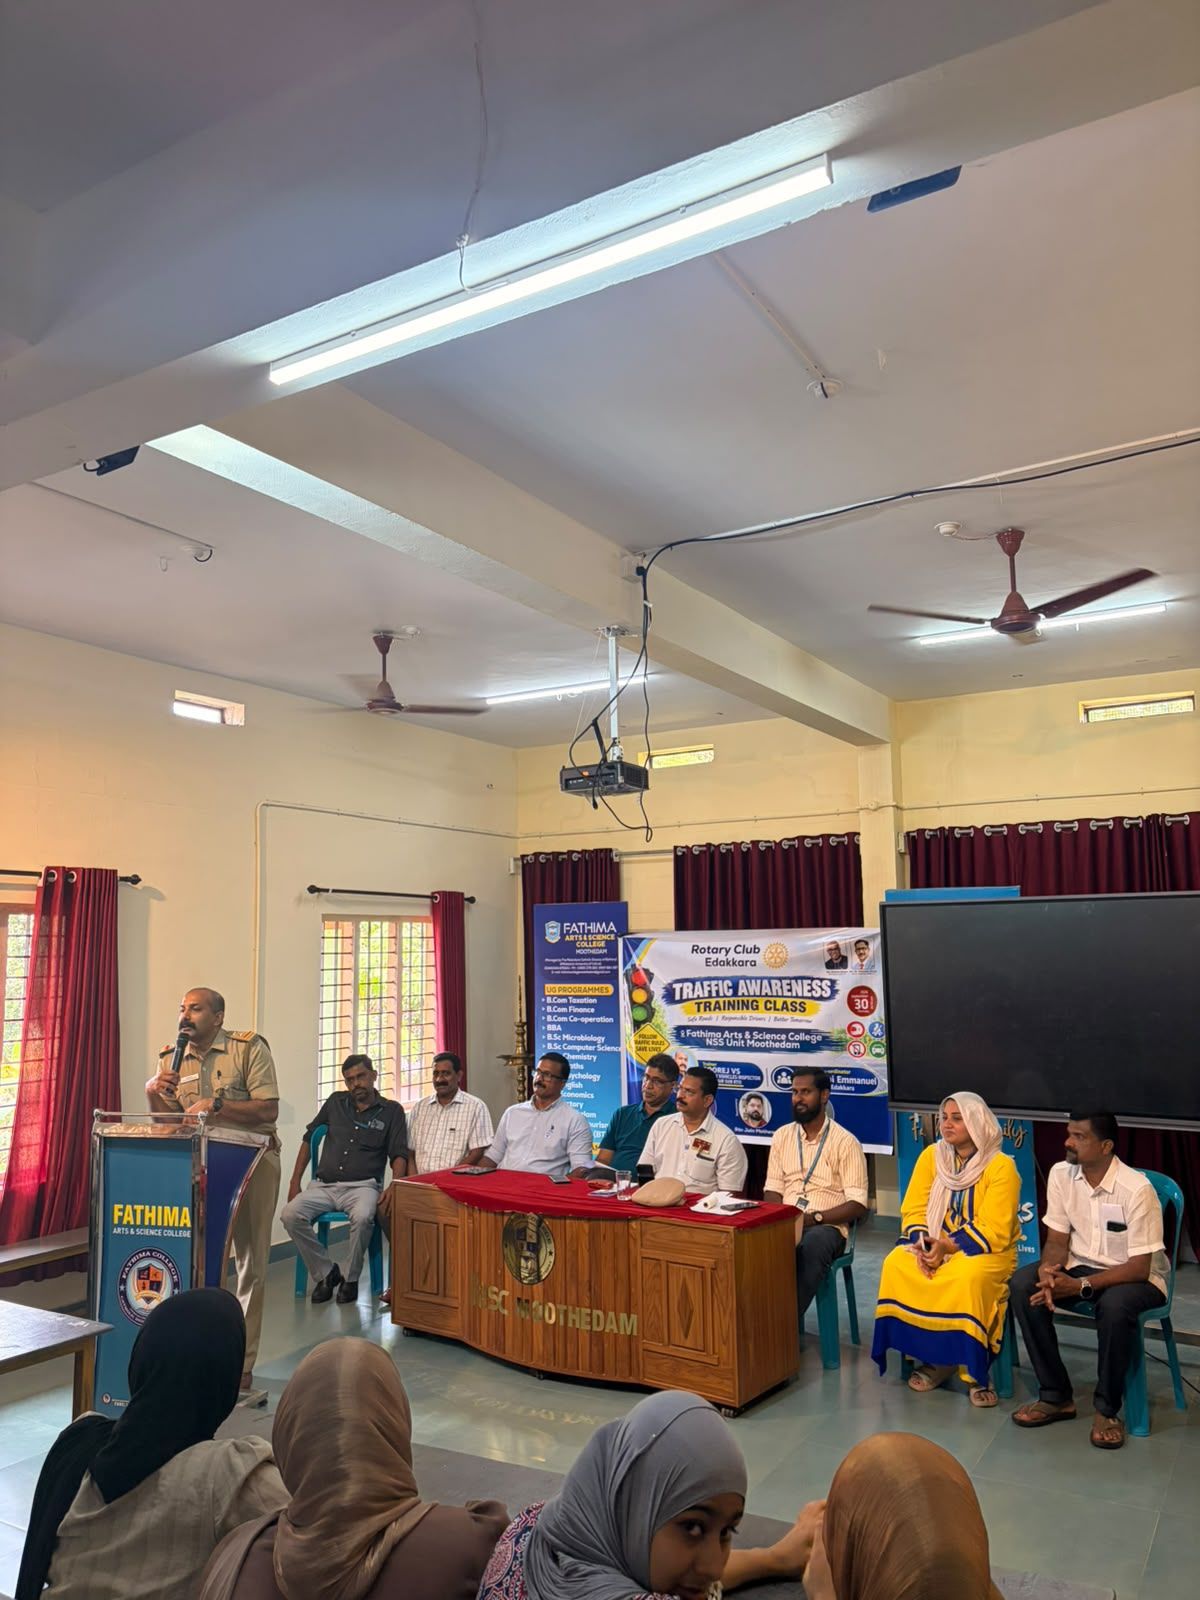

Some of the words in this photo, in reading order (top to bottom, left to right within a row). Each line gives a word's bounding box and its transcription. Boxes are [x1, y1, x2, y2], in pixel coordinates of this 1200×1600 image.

[563, 921, 617, 934] FATHIMA
[588, 933, 616, 941] SCIENCE
[575, 940, 606, 948] COLLEGE
[690, 944, 731, 956] Rotary
[733, 944, 760, 954] Club
[704, 957, 757, 967] Edakkara
[546, 986, 557, 994] UG
[557, 986, 610, 994] PROGRAMMES
[672, 979, 733, 1001] TRAFFIC
[737, 979, 832, 998] AWARENESS
[546, 996, 568, 1004] B.Com
[568, 996, 598, 1004] Taxation
[854, 998, 869, 1010] 30
[546, 1005, 568, 1013] B.Com
[568, 1005, 595, 1014] Finance
[694, 999, 759, 1013] TRAINING
[764, 1000, 807, 1013] CLASS
[546, 1014, 568, 1023] B.Com
[568, 1015, 614, 1024] Co-operation
[546, 1024, 562, 1032] BBA
[546, 1033, 562, 1041] B.Sc
[562, 1034, 606, 1044] Microbiology
[686, 1029, 721, 1039] Fathima
[722, 1030, 741, 1039] Arts
[744, 1031, 752, 1039] &
[752, 1031, 787, 1040] Science
[788, 1032, 822, 1044] College
[546, 1042, 562, 1050] B.Sc
[562, 1043, 596, 1052] Computer
[705, 1037, 725, 1047] NSS
[726, 1038, 745, 1048] Unit
[746, 1039, 801, 1049] Moothedam
[836, 1075, 877, 1086] Emmanuel
[113, 1203, 192, 1228] FATHIMA
[112, 1227, 130, 1235] ARTS
[130, 1227, 136, 1235] &
[136, 1228, 162, 1237] SCIENCE
[163, 1229, 192, 1238] COLLEGE
[121, 1250, 152, 1280] FATHIMA
[151, 1251, 179, 1283] COLLEGE
